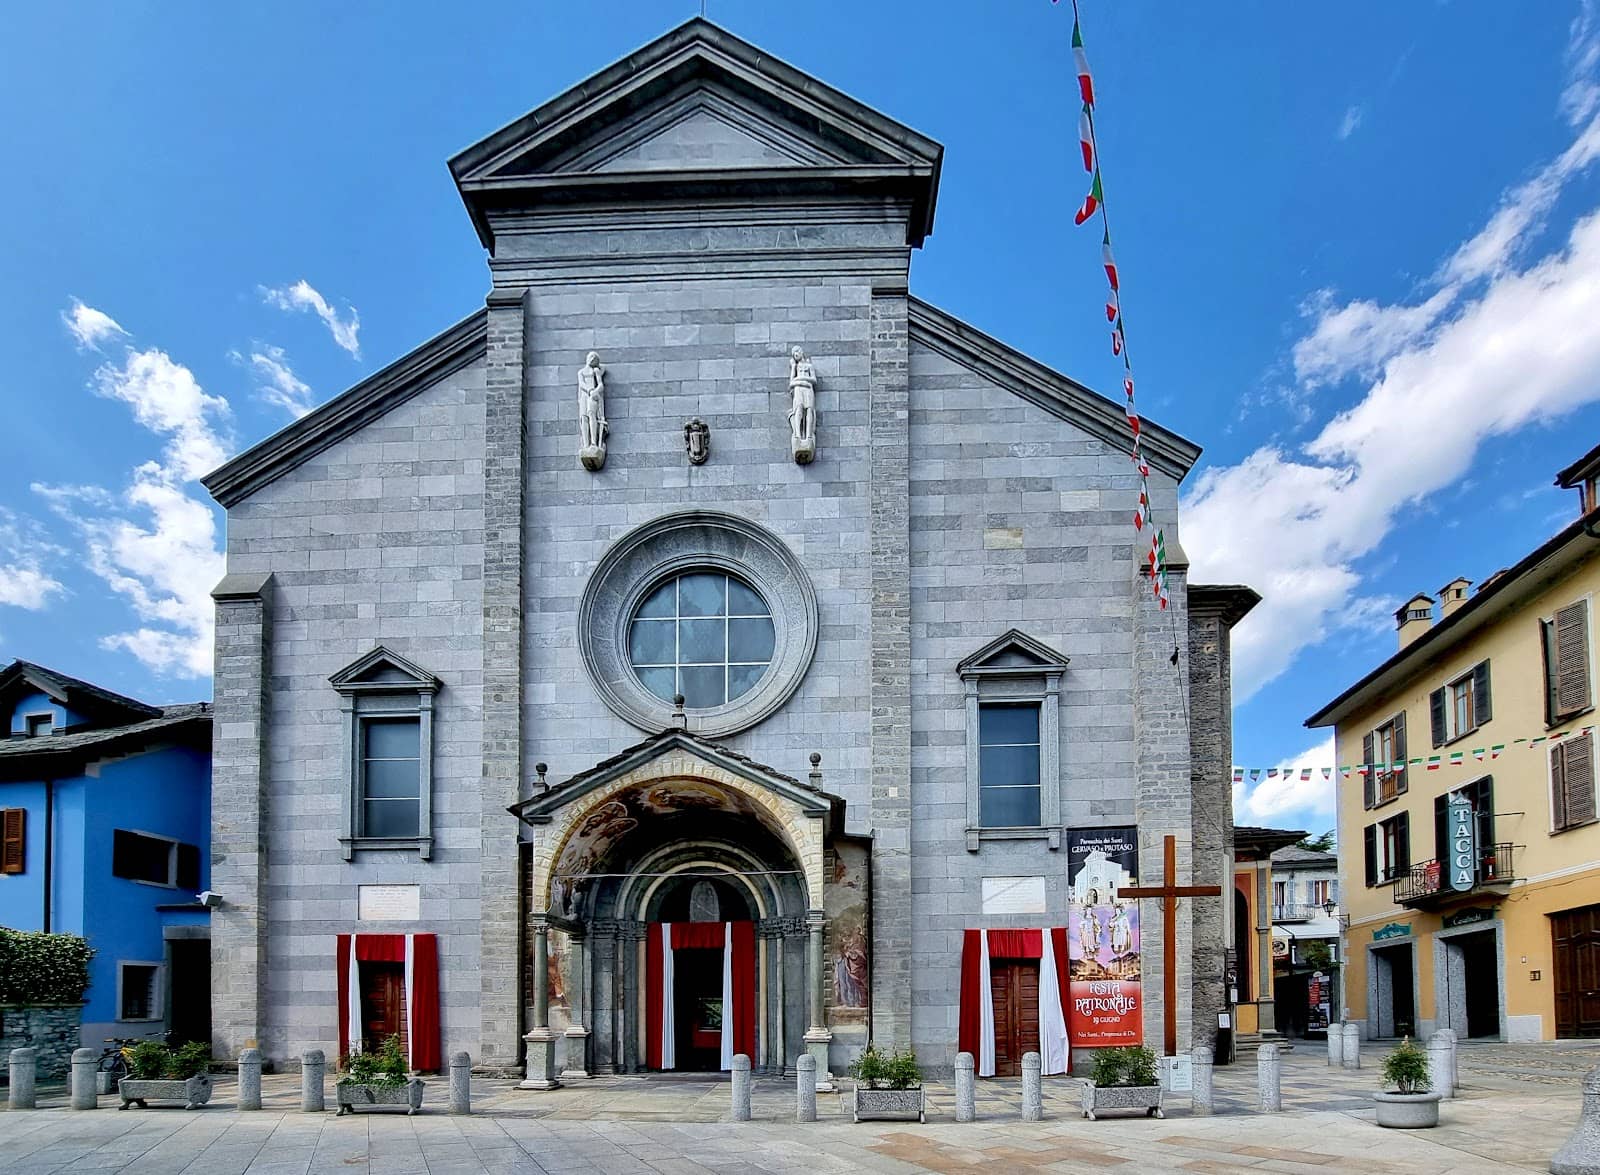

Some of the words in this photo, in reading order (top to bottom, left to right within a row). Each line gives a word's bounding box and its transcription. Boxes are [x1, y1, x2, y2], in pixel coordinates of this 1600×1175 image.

[1071, 845, 1100, 853] GERVASO
[1104, 844, 1133, 852] PROTASO
[1454, 808, 1472, 884] TACCA
[1089, 982, 1121, 997] FESTA
[1075, 996, 1137, 1016] PATRONALE
[1093, 1016, 1099, 1024] 19
